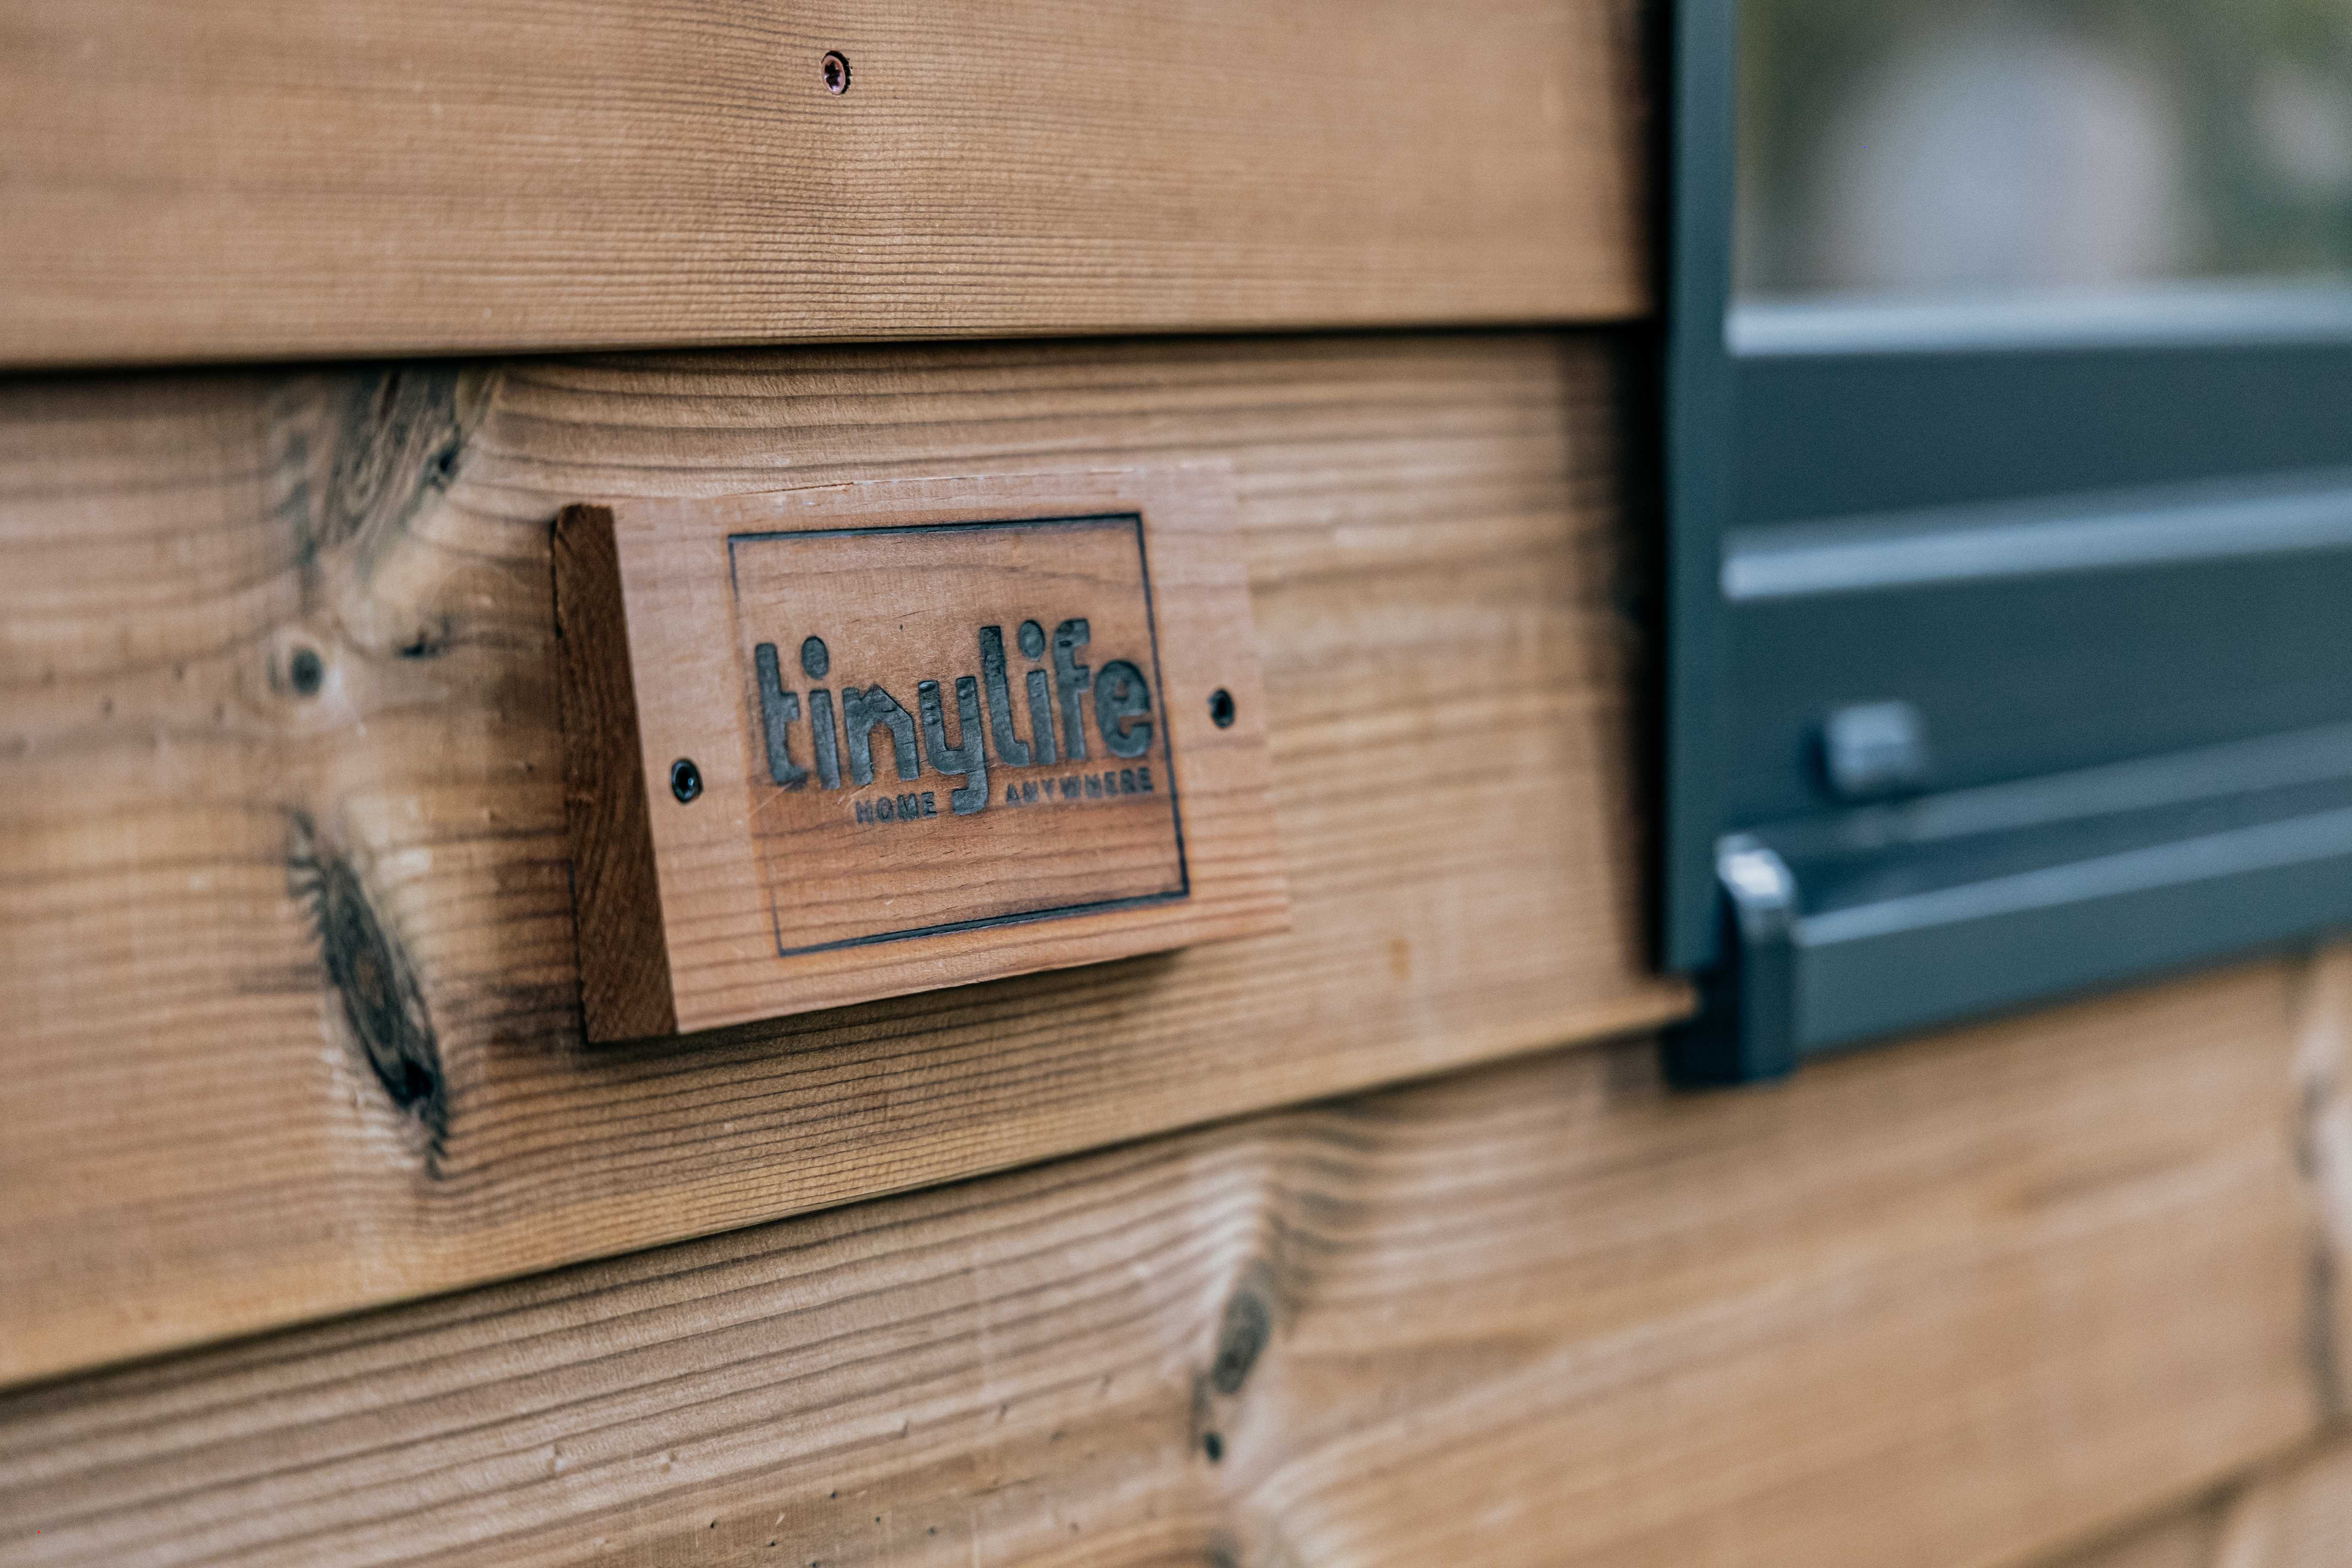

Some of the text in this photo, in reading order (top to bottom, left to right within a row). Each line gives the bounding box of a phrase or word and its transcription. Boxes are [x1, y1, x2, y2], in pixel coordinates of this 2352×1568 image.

[755, 618, 1154, 815] tinylife
[856, 767, 1154, 824] HOME ANYWHERE
